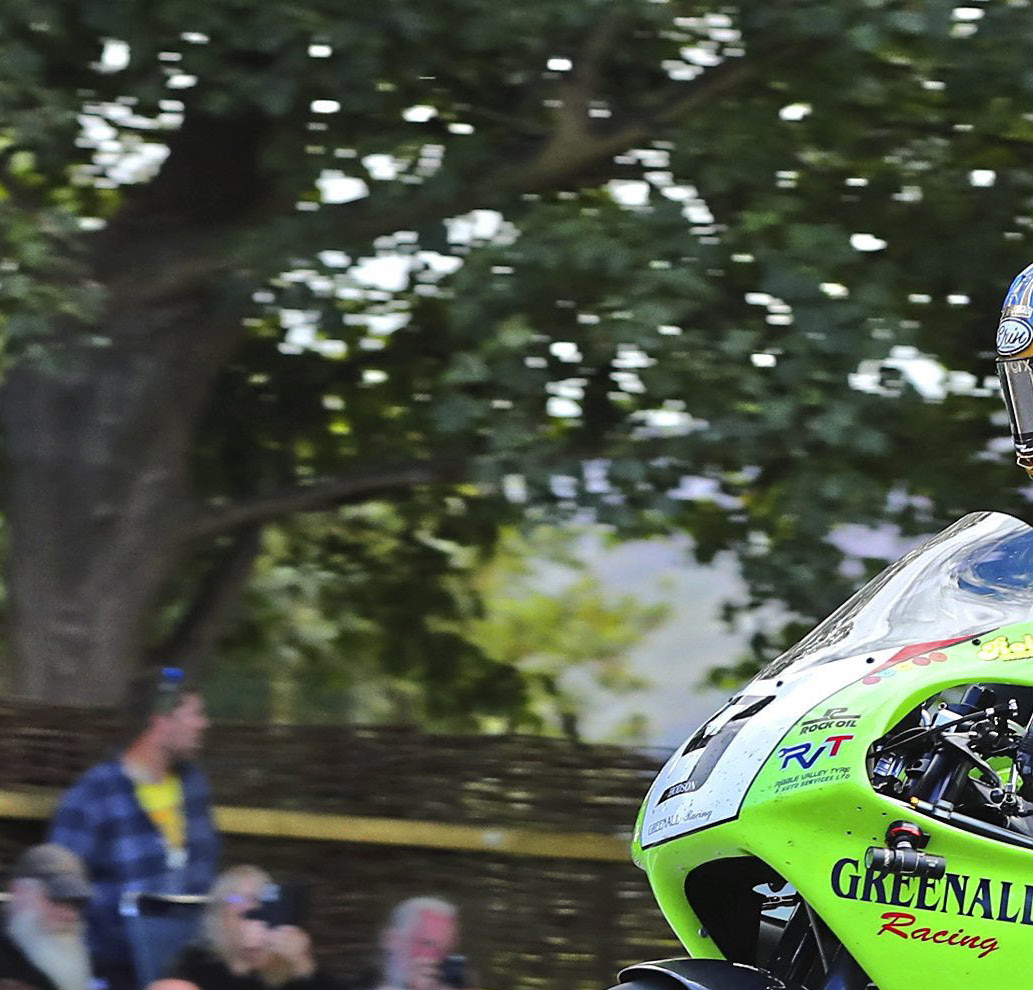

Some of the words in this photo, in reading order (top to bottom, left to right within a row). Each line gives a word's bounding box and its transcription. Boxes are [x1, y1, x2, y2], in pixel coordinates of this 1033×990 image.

[800, 720, 835, 736] ROCK
[836, 716, 858, 729] OIL
[801, 769, 829, 780] VALLEY
[876, 911, 1000, 959] Racing
